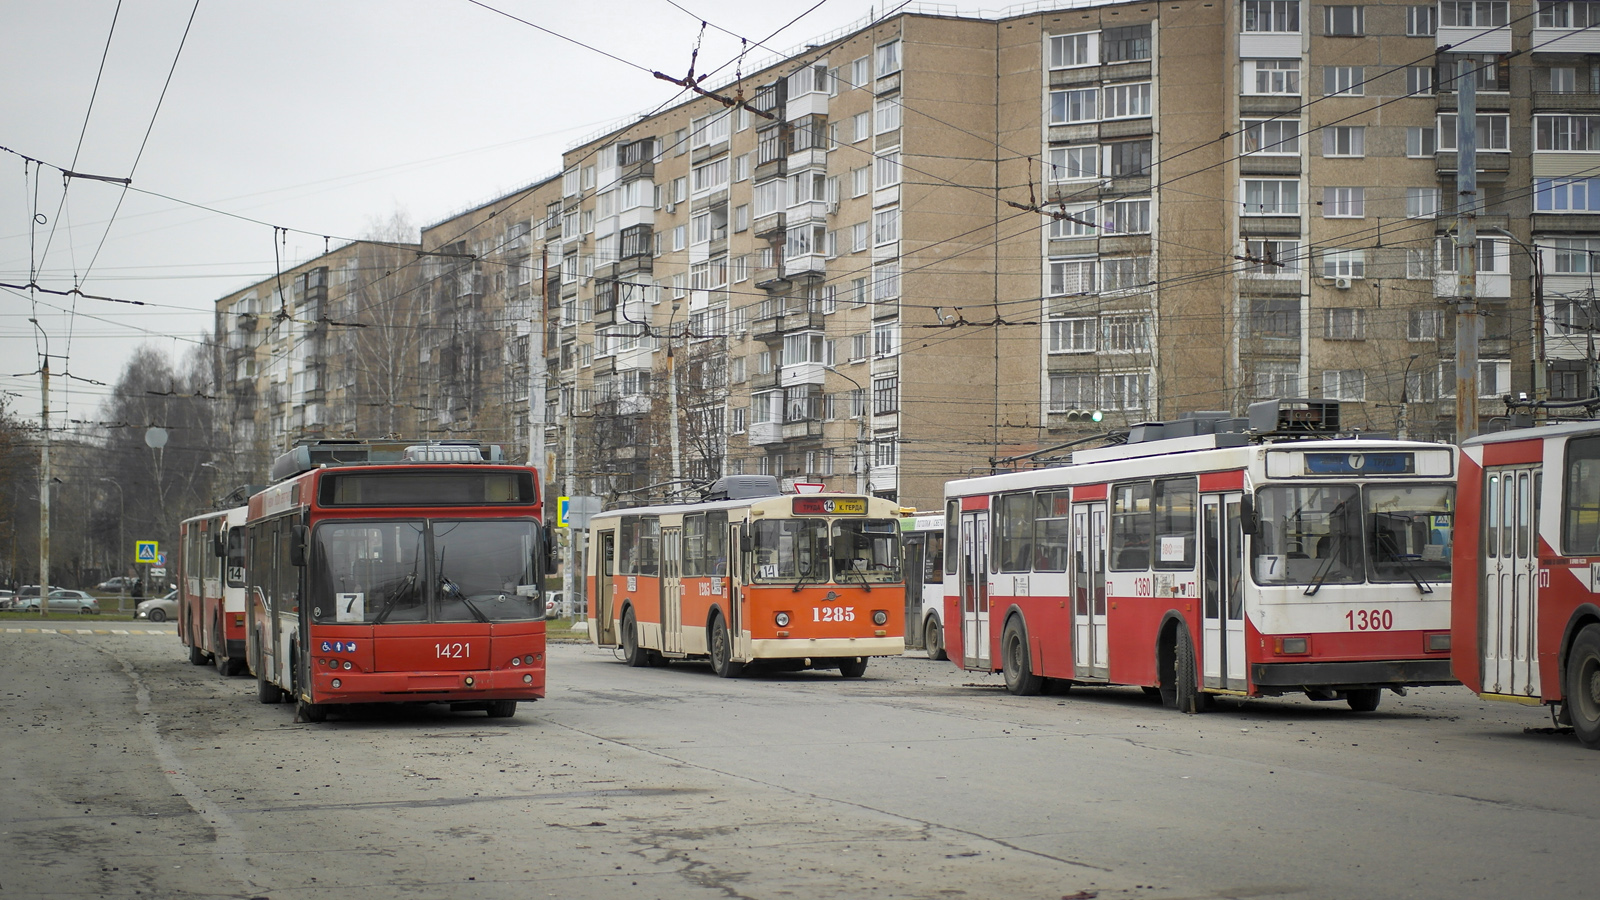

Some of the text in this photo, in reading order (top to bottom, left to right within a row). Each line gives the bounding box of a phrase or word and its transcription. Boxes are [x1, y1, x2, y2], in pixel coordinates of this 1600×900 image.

[1352, 454, 1361, 468] 7
[824, 501, 834, 511] 14
[229, 567, 242, 580] 14
[763, 565, 775, 578] 14
[1267, 556, 1278, 575] 7
[1134, 577, 1151, 597] 1360
[343, 595, 357, 614] 7
[812, 606, 855, 622] 1285
[1345, 609, 1393, 630] 1360
[434, 642, 470, 659] 1421
